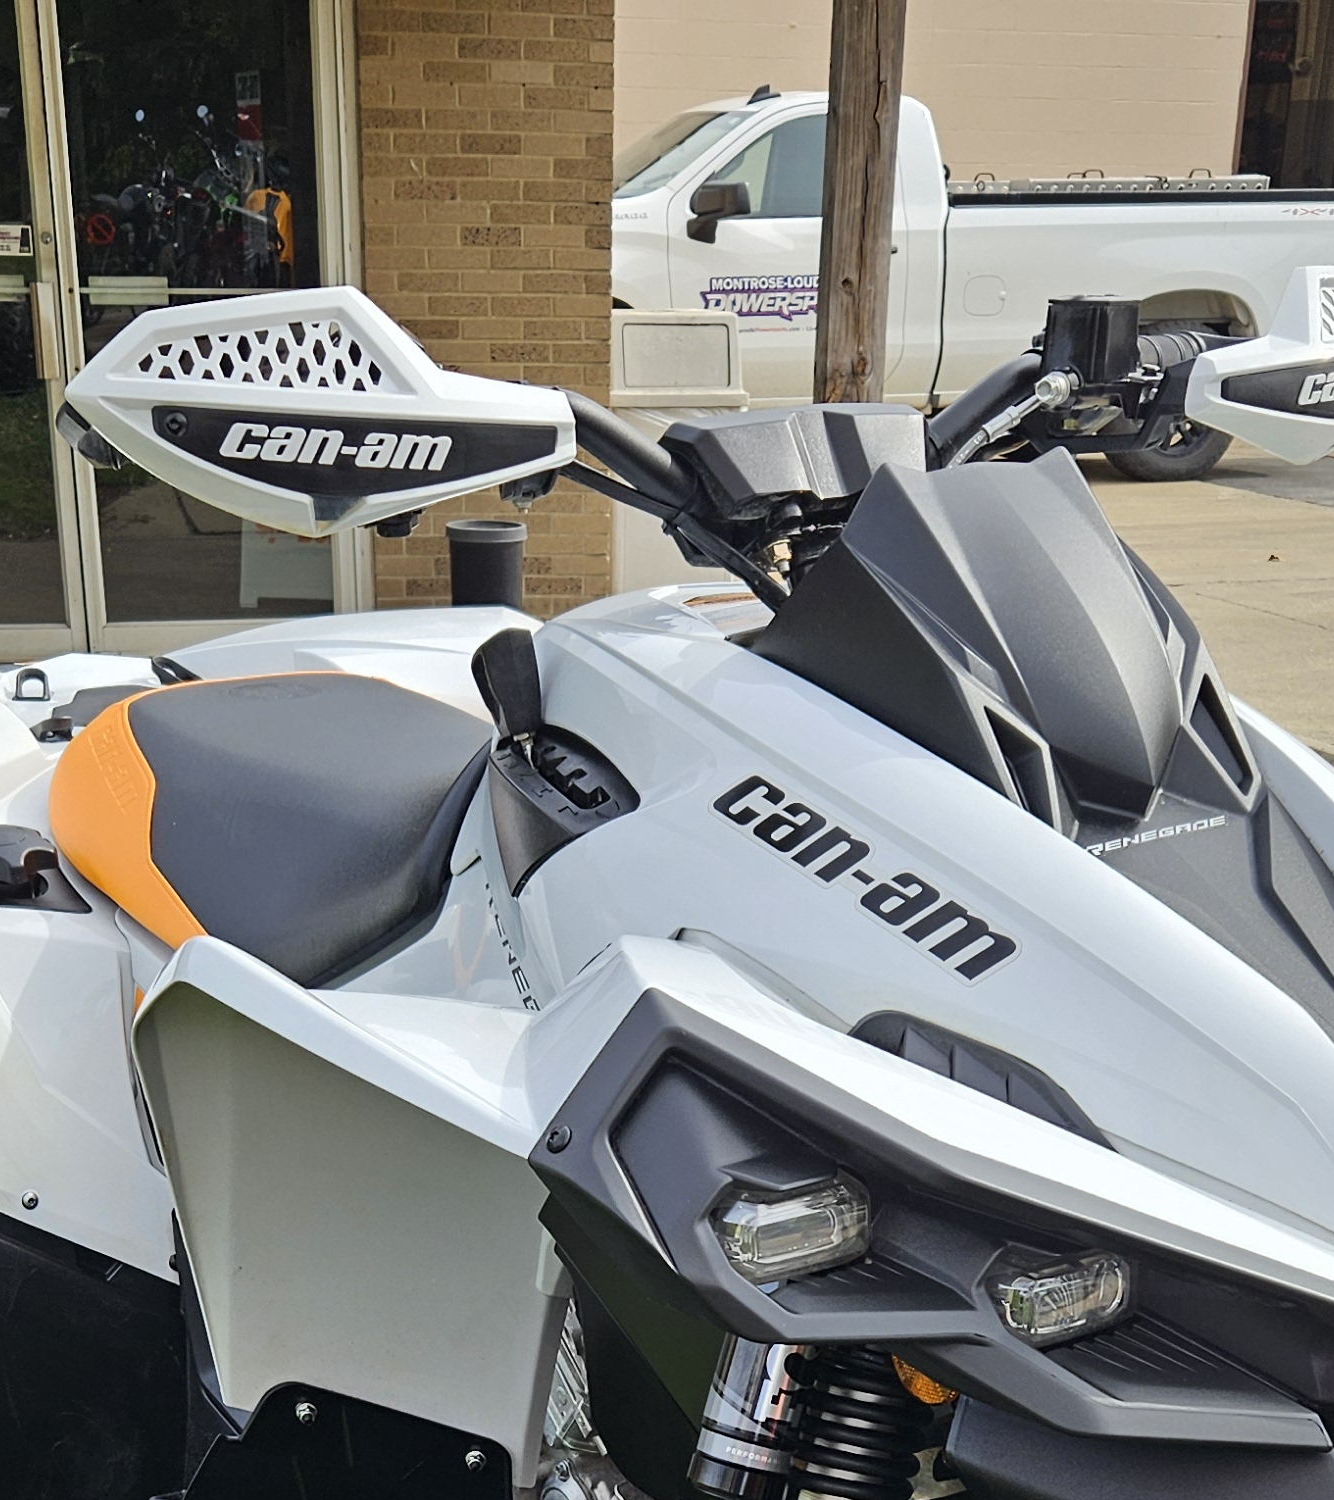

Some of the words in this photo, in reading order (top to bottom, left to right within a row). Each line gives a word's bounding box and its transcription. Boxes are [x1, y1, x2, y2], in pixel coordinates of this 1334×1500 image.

[219, 422, 453, 471] can-am
[1085, 815, 1226, 857] RENEGADE
[712, 775, 1018, 981] can-am
